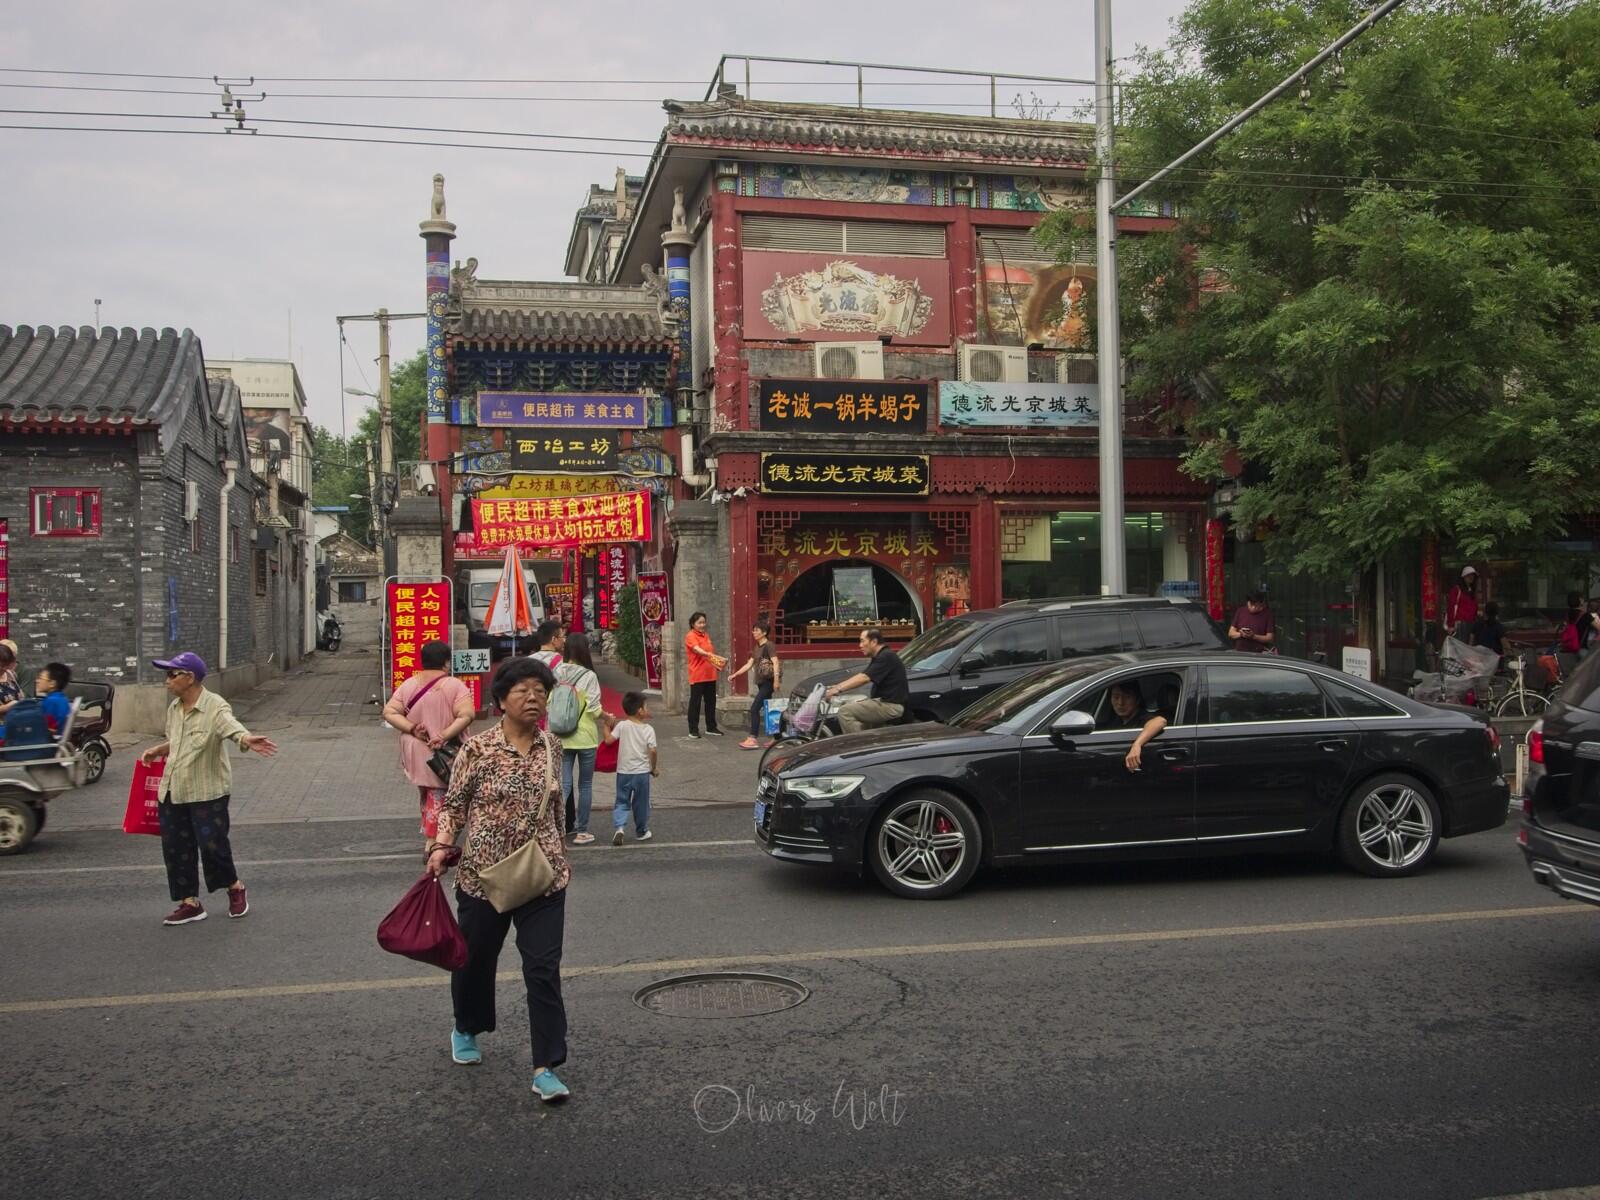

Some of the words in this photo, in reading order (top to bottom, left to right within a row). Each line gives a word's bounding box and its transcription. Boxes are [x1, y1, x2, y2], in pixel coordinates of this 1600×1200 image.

[523, 402, 575, 419] 便民超市
[583, 403, 636, 420] 美食主食
[768, 389, 921, 423] 老诚一锅羊蝎子
[951, 394, 1093, 414] 德流光京城菜
[503, 477, 617, 493] 工坊琉璃艺术馆
[768, 463, 923, 485] 德流光京城菜
[478, 494, 631, 525] 便民超市美食欢迎您
[763, 528, 940, 557] 德流光京城菜
[396, 587, 416, 668] 便民超市美食
[420, 587, 441, 648] 人均15元
